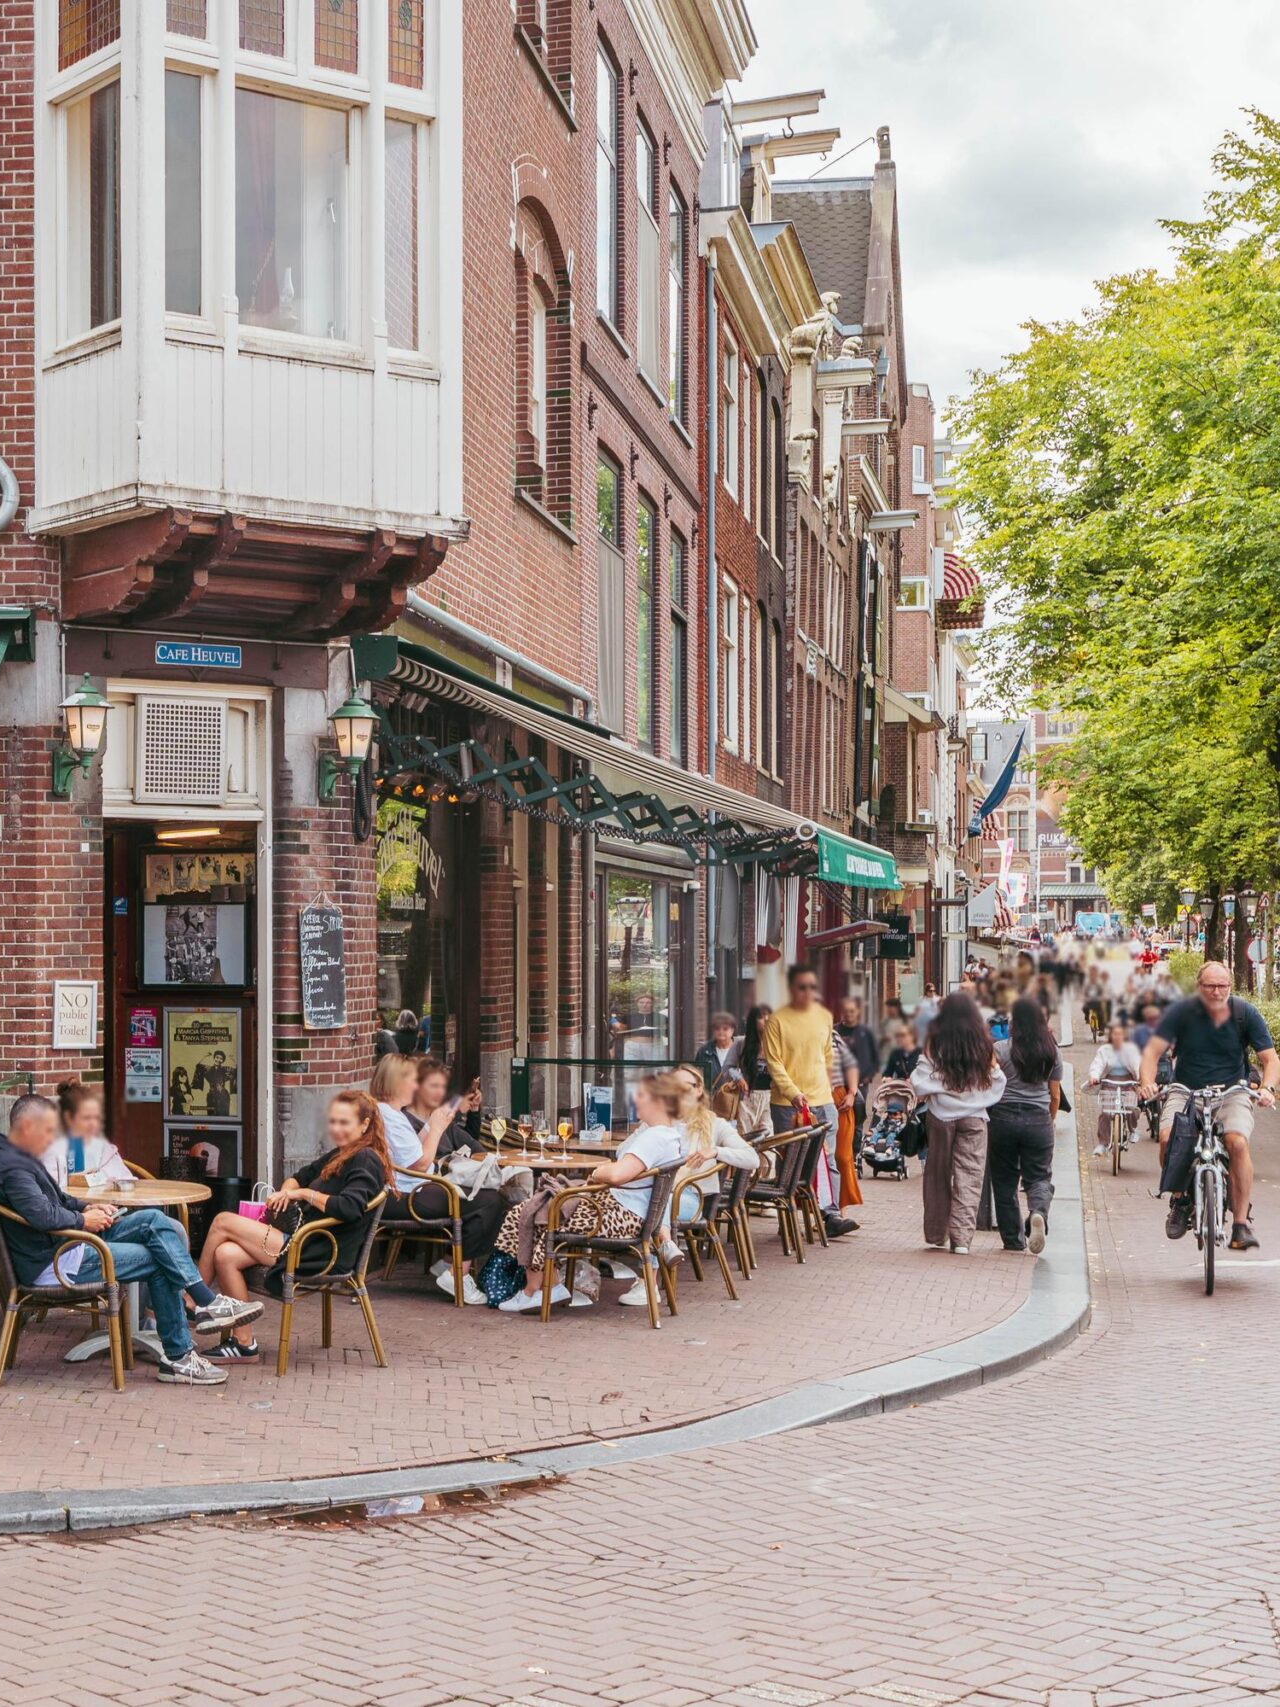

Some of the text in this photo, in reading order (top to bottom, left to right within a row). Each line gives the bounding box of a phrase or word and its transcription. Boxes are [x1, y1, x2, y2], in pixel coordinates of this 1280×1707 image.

[191, 647, 239, 664] HEUVEL
[882, 933, 908, 942] vintage
[61, 992, 88, 1008] NO
[59, 1009, 88, 1022] public
[58, 1024, 88, 1036] Toilet!
